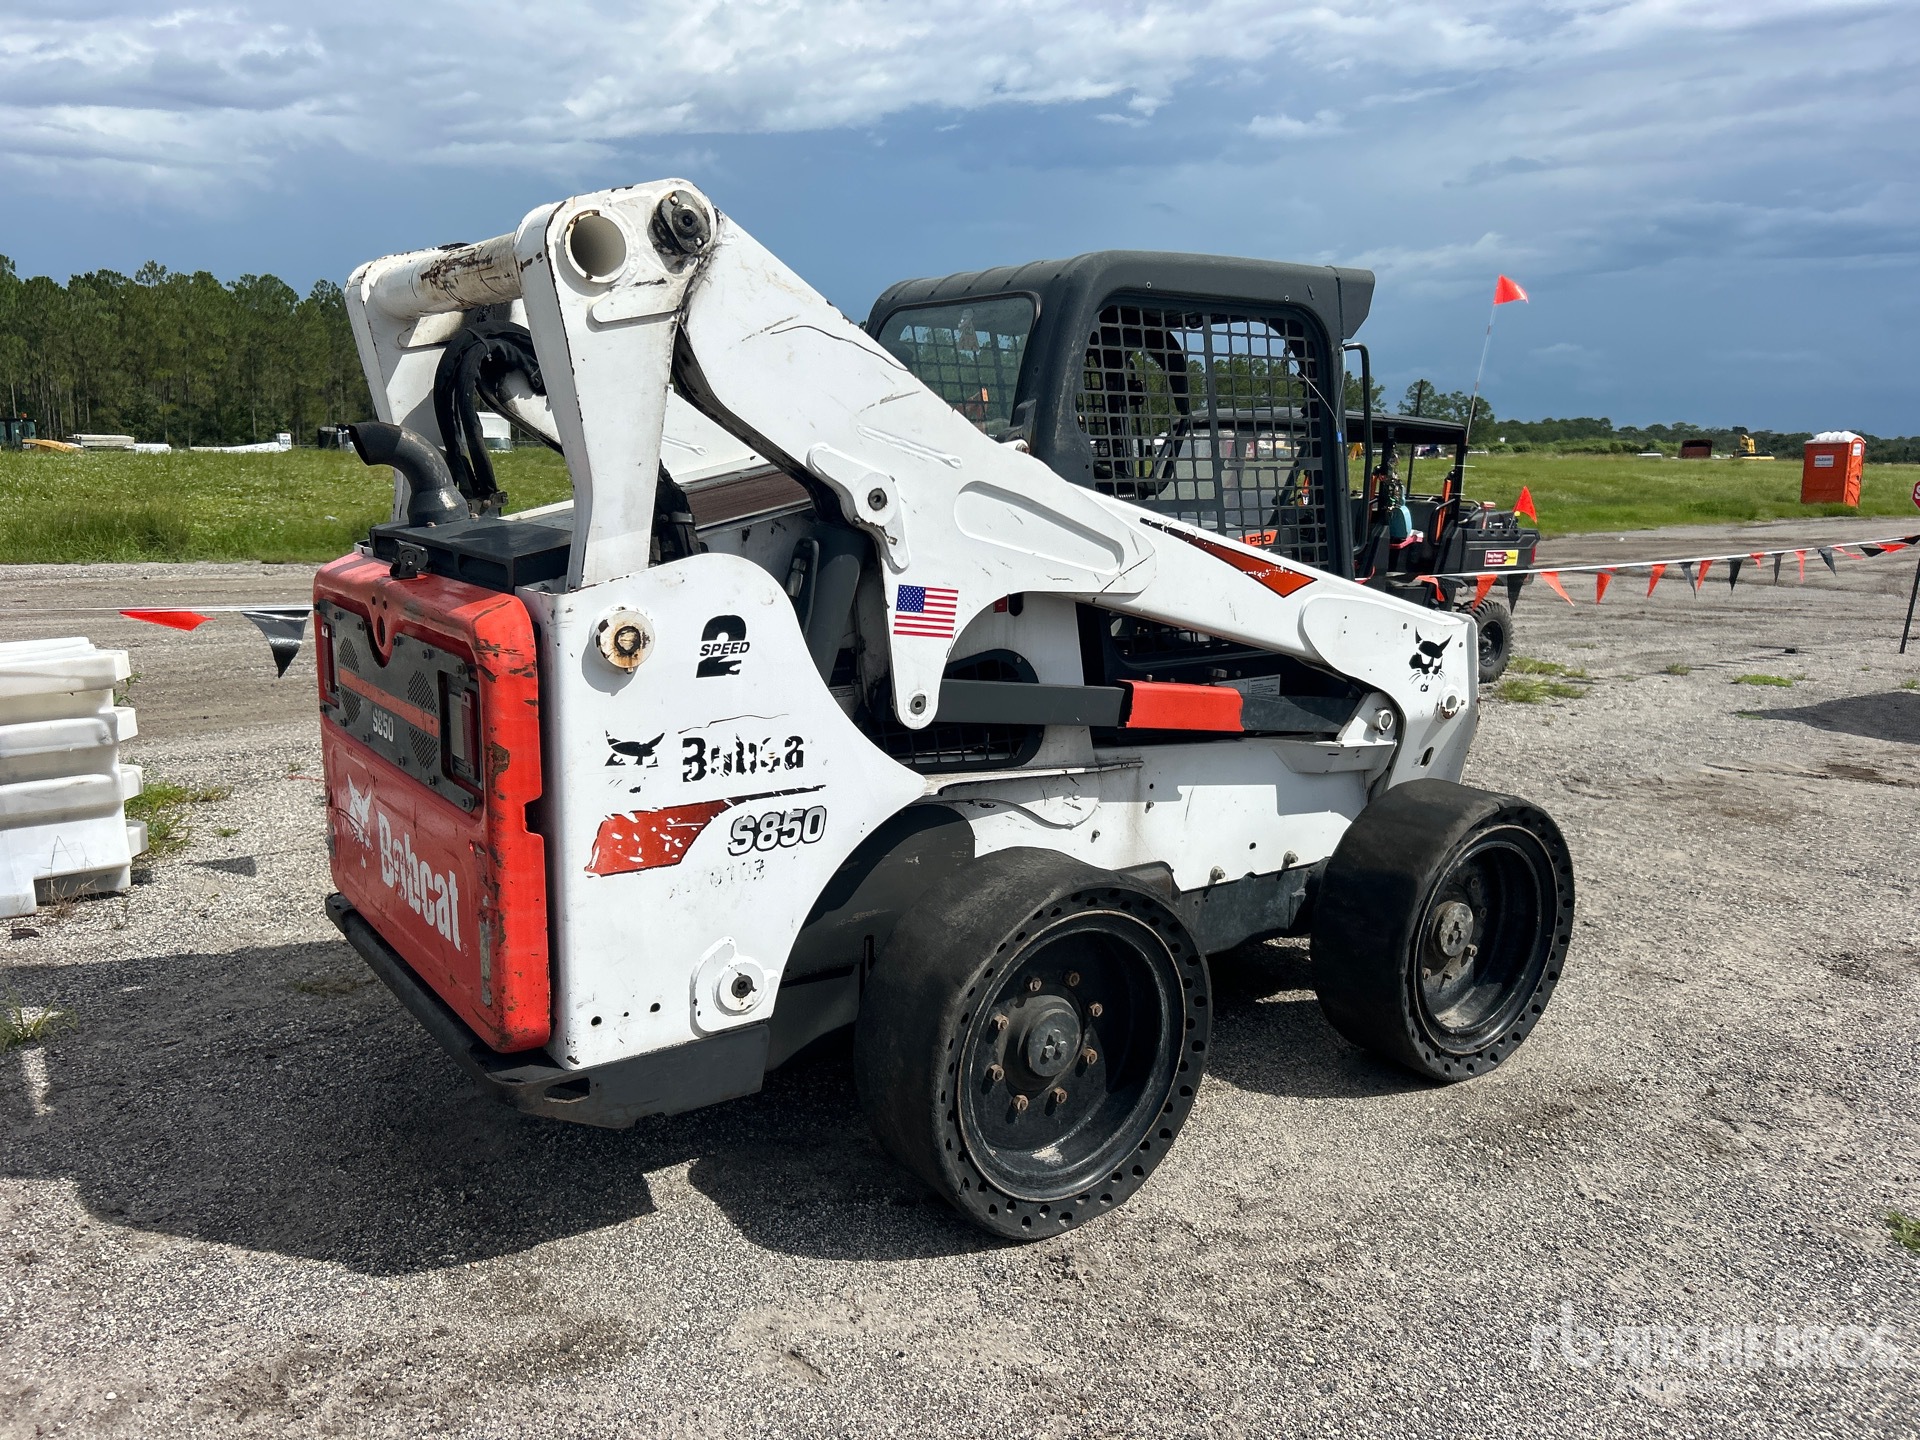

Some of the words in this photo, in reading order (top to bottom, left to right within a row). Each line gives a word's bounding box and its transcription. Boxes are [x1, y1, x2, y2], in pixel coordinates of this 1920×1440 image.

[1249, 535, 1271, 544] PRO
[699, 641, 751, 657] SPEED
[372, 707, 394, 742] S850
[727, 805, 828, 857] S850
[377, 810, 462, 952] Bobcat
